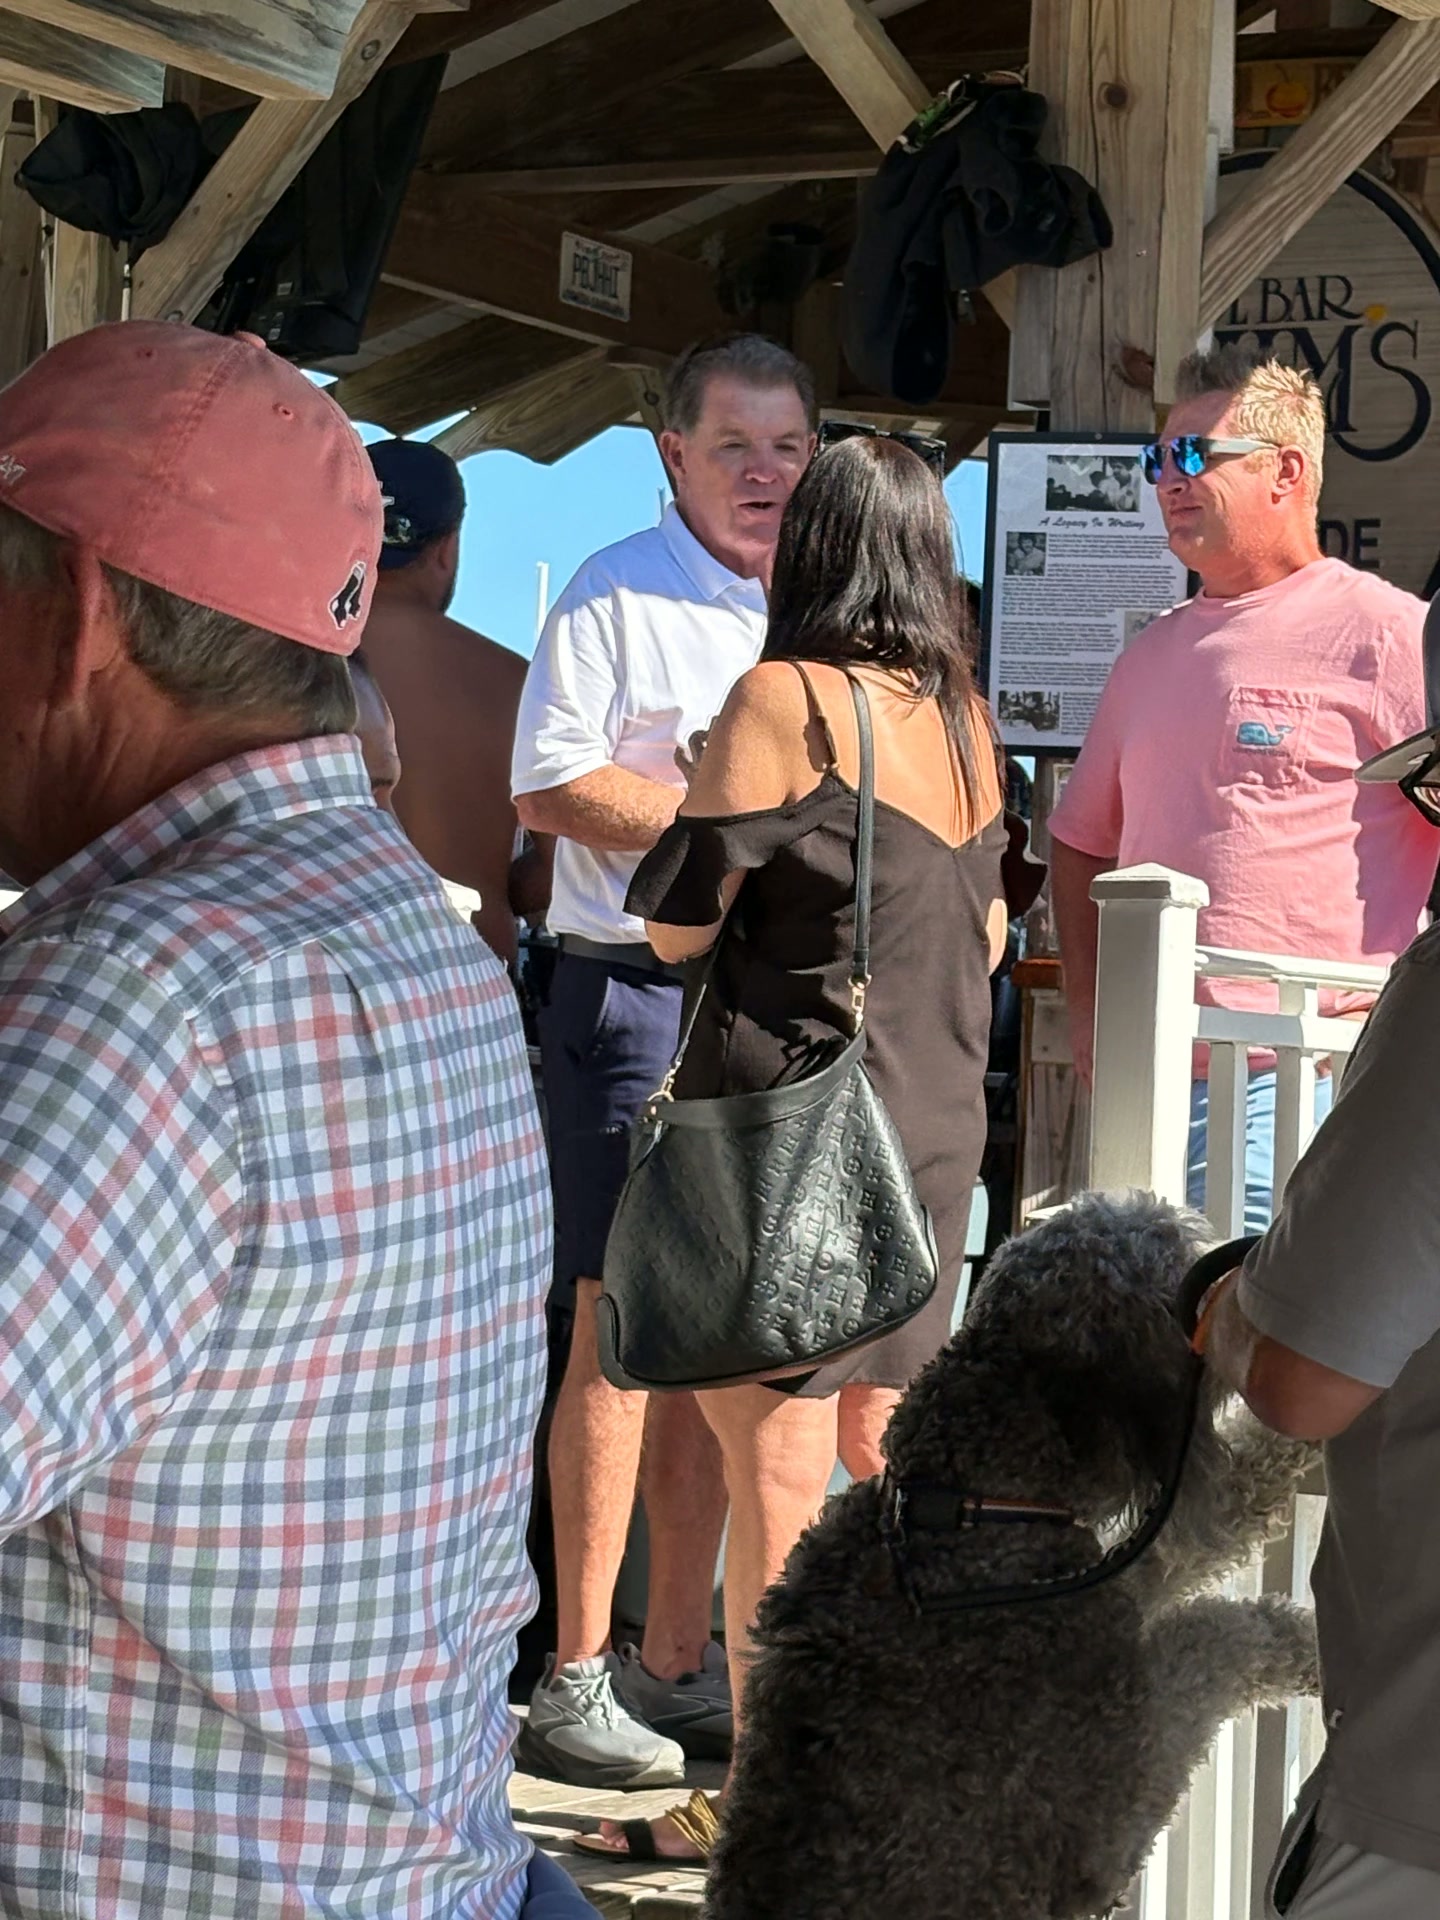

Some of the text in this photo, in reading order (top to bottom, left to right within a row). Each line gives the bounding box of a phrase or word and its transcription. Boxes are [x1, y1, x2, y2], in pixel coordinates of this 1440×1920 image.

[1257, 274, 1365, 323] BAR
[1038, 516, 1145, 531] A Legacy In Writing
